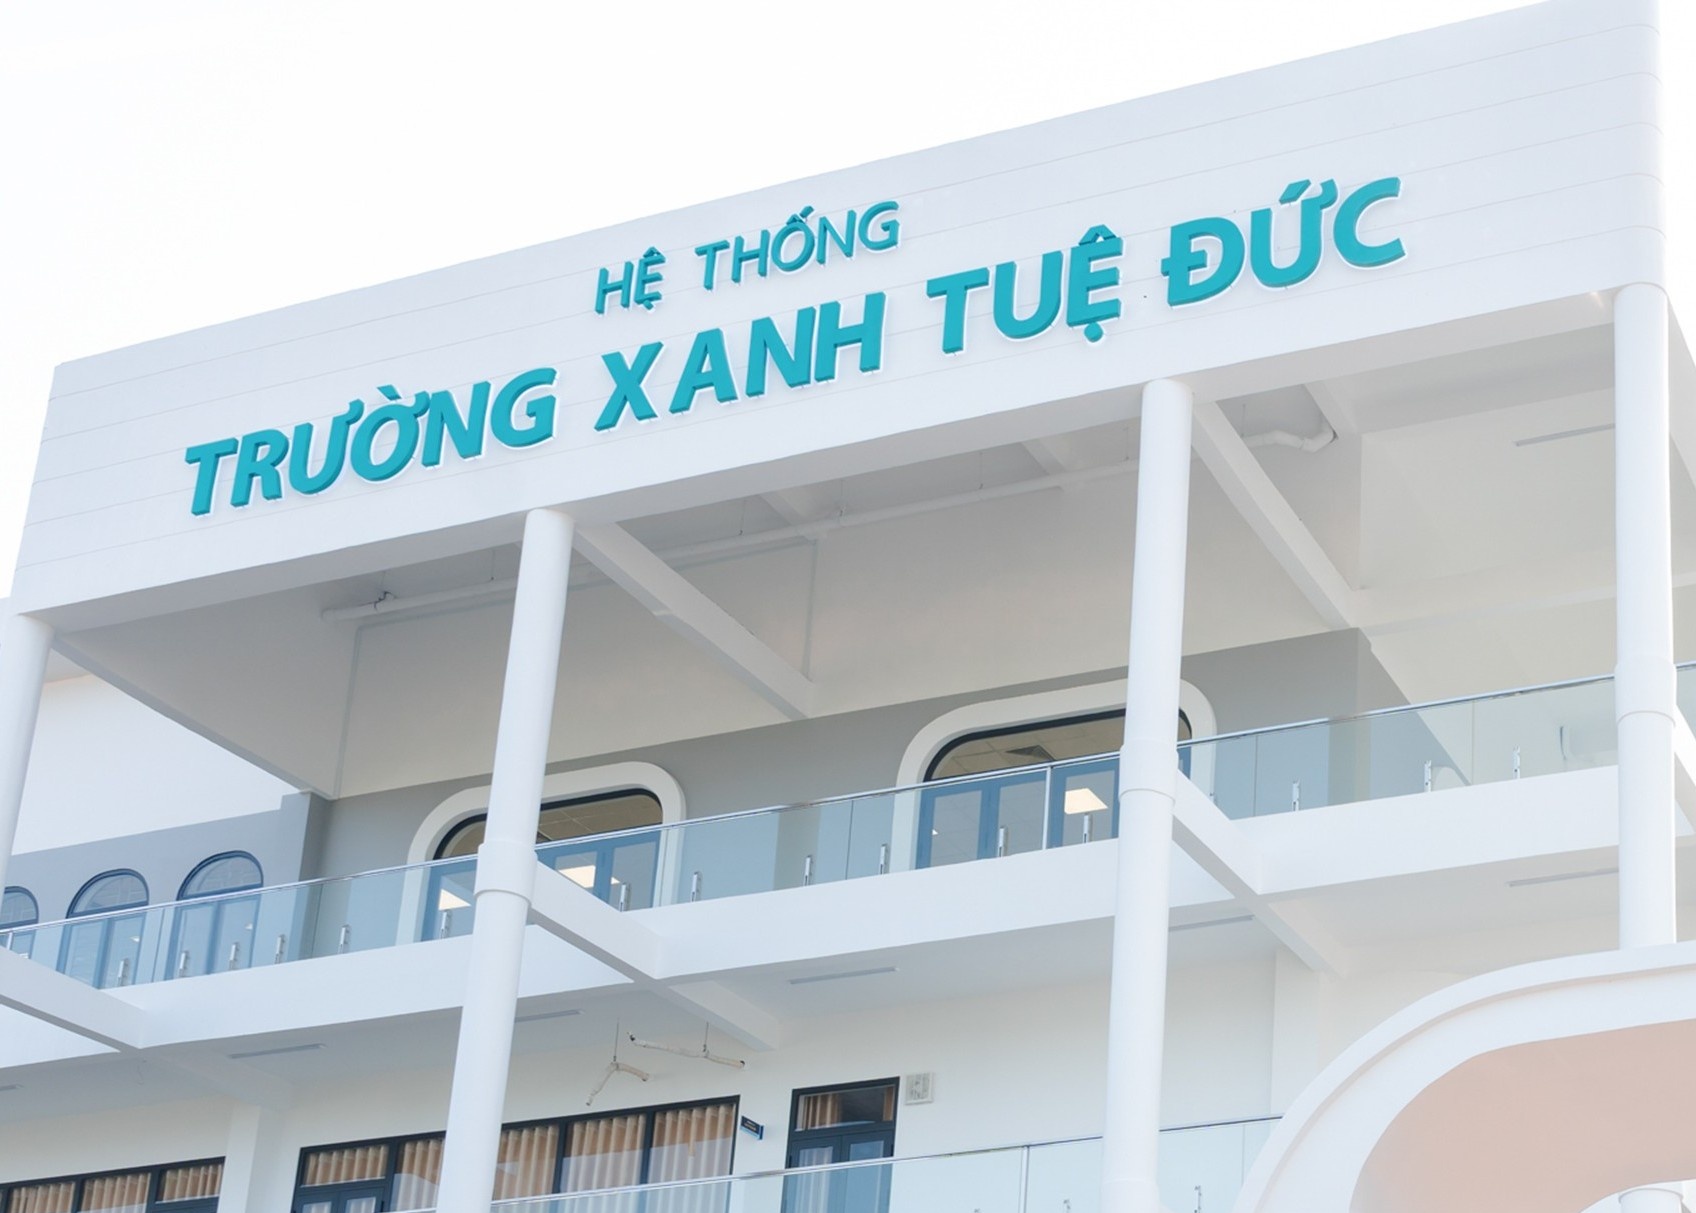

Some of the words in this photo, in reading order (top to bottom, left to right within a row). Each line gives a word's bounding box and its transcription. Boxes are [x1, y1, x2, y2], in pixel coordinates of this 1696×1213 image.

[185, 367, 557, 516] TRƯỜNG
[594, 292, 885, 431] XANH
[926, 225, 1123, 355] TUỆ
[1161, 177, 1405, 306] ĐỨC
[595, 262, 665, 314] HỆ
[695, 206, 899, 290] THỐNG
